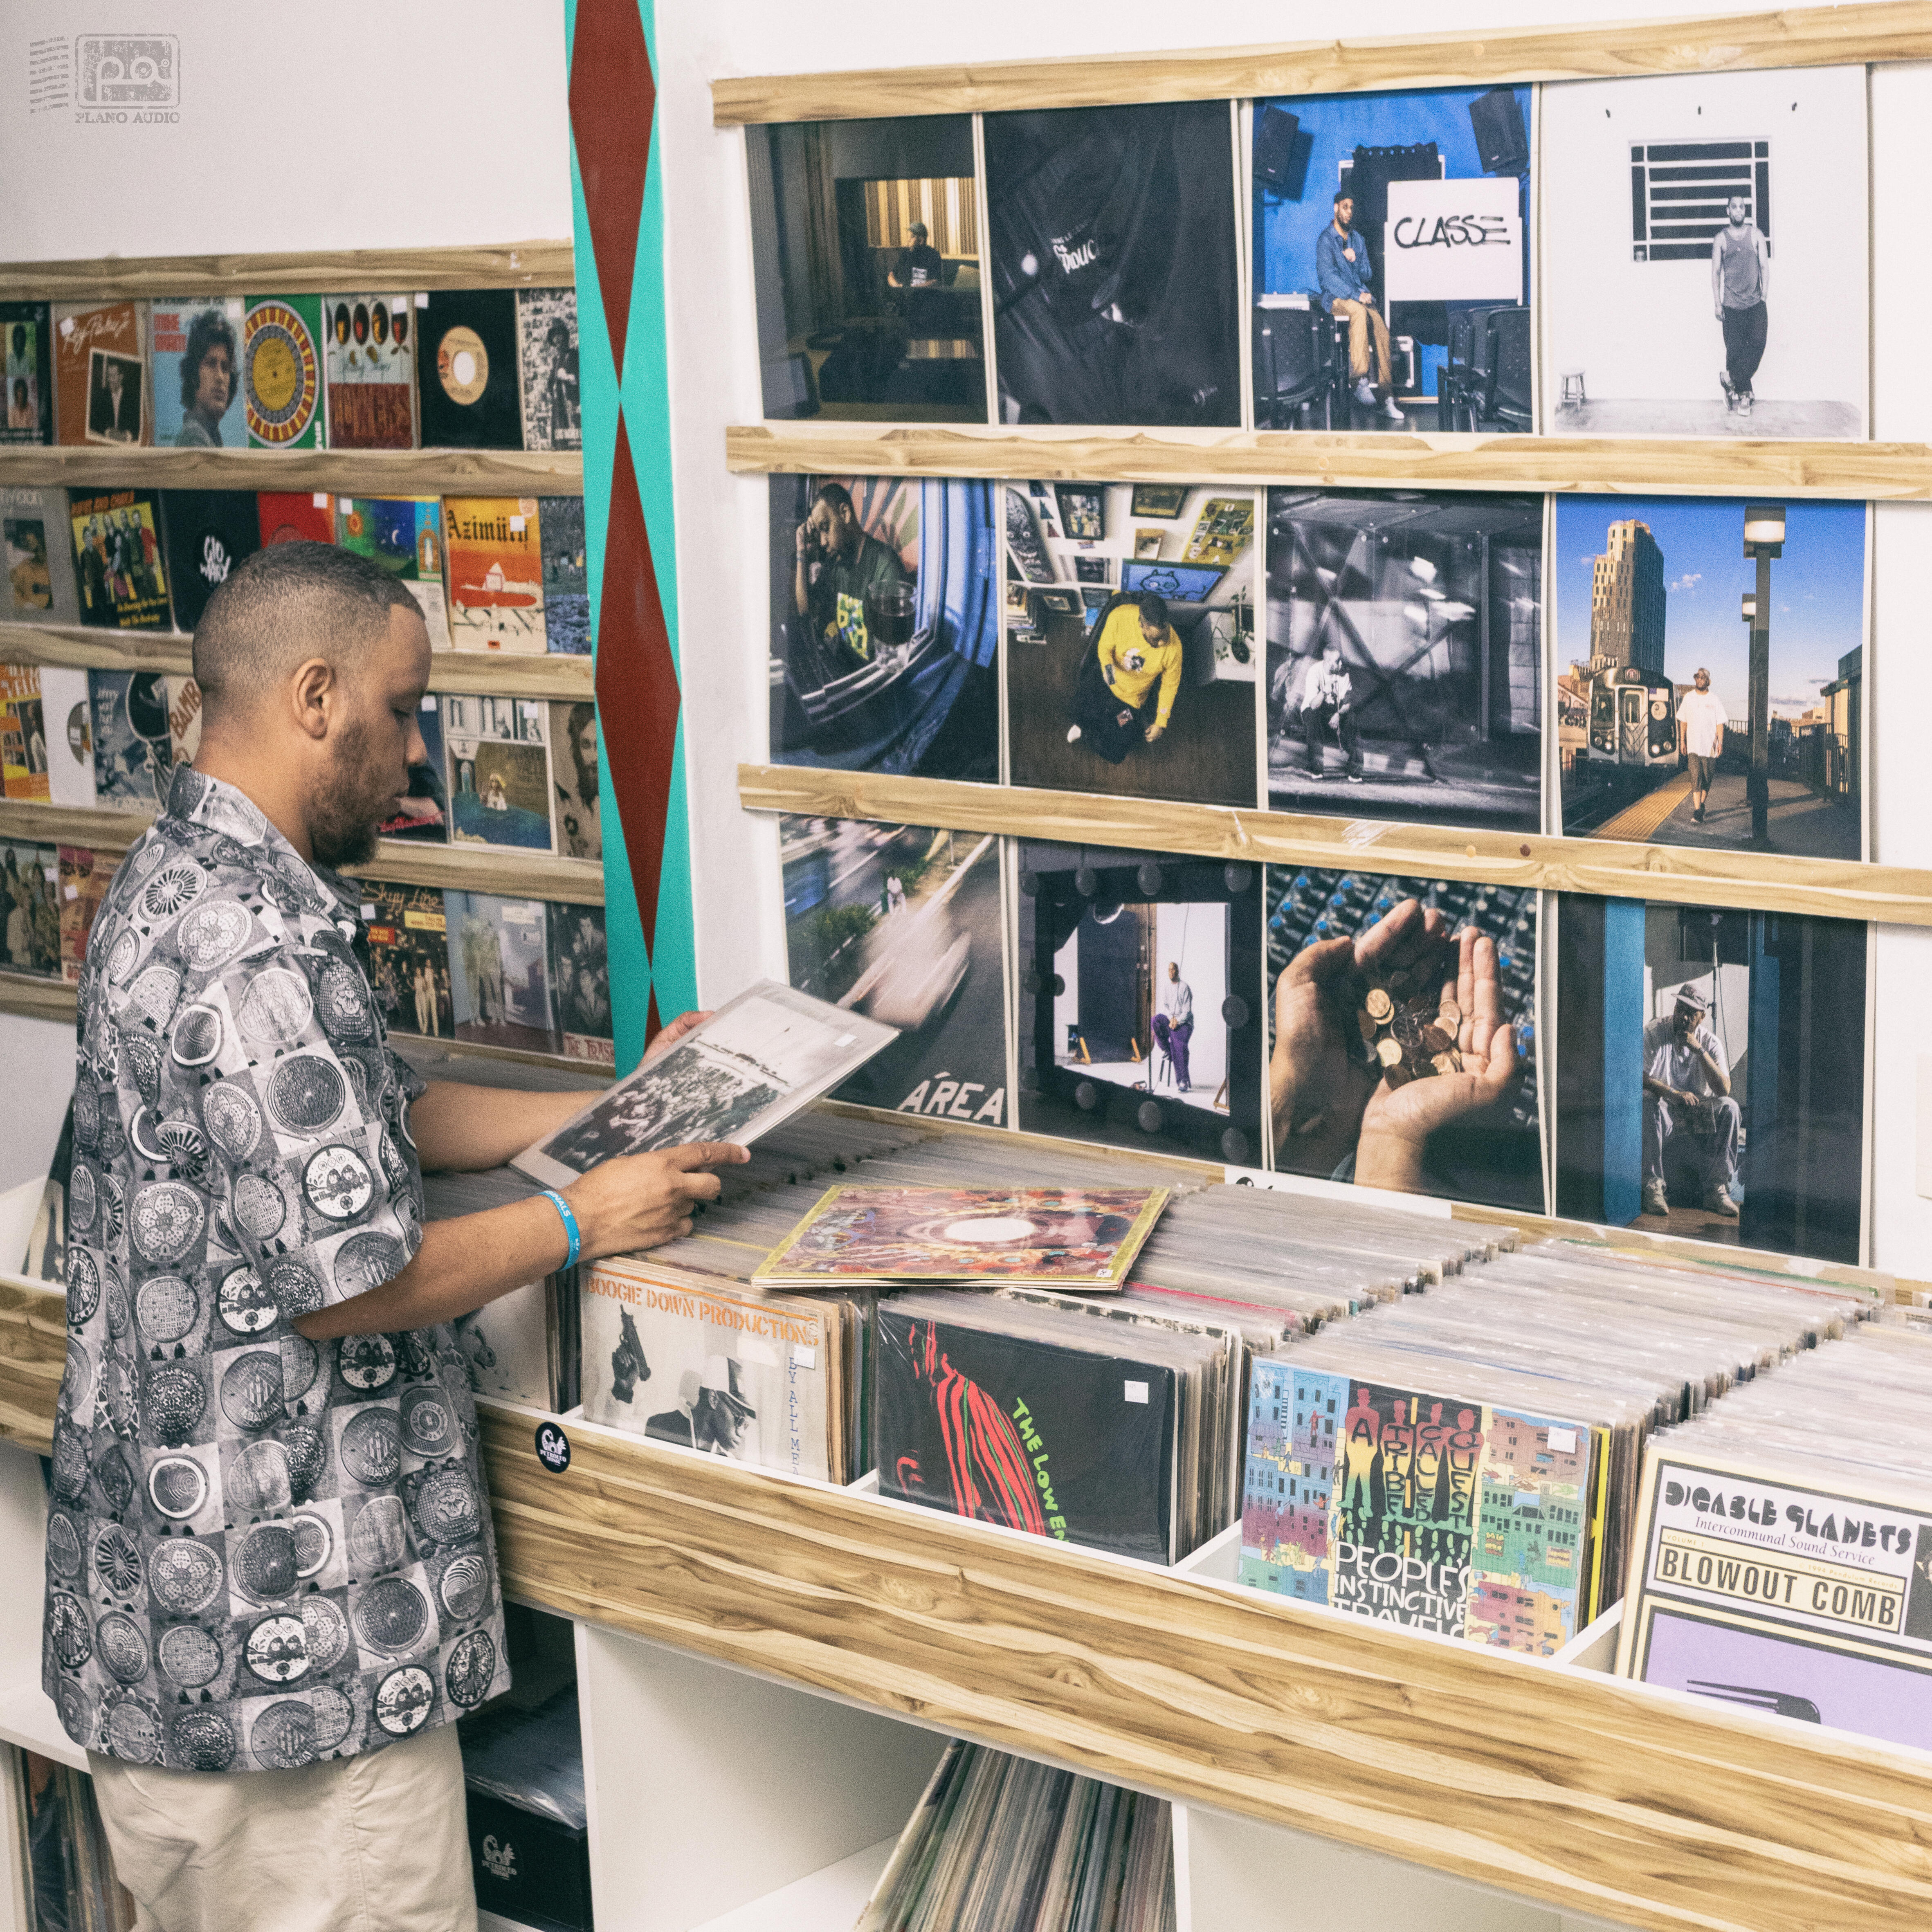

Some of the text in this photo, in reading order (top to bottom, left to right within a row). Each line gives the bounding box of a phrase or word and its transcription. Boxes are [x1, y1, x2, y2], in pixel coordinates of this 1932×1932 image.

[1394, 214, 1511, 249] CLASSE
[897, 1071, 1005, 1124] ÁREA
[585, 1277, 642, 1305] BOOGIE
[646, 1292, 695, 1319] DOWN
[1013, 1397, 1044, 1453] THE
[1034, 1454, 1059, 1510] LOW
[1351, 1418, 1373, 1447] A
[1384, 1424, 1411, 1515] TRIBE
[1415, 1425, 1441, 1522] CALLED
[1447, 1433, 1476, 1533] QUEST
[1665, 1481, 1778, 1526] DIGABLE
[1666, 1534, 1698, 1547] VOLUME
[1695, 1516, 1875, 1566] Intercommunal Sound Service
[1335, 1543, 1472, 1600] PEOPLE'S
[1662, 1548, 1896, 1626] BLOWOUT COMB
[1807, 1563, 1827, 1575] 1994
[1829, 1568, 1866, 1584] Pendulum
[1868, 1577, 1898, 1589] Records
